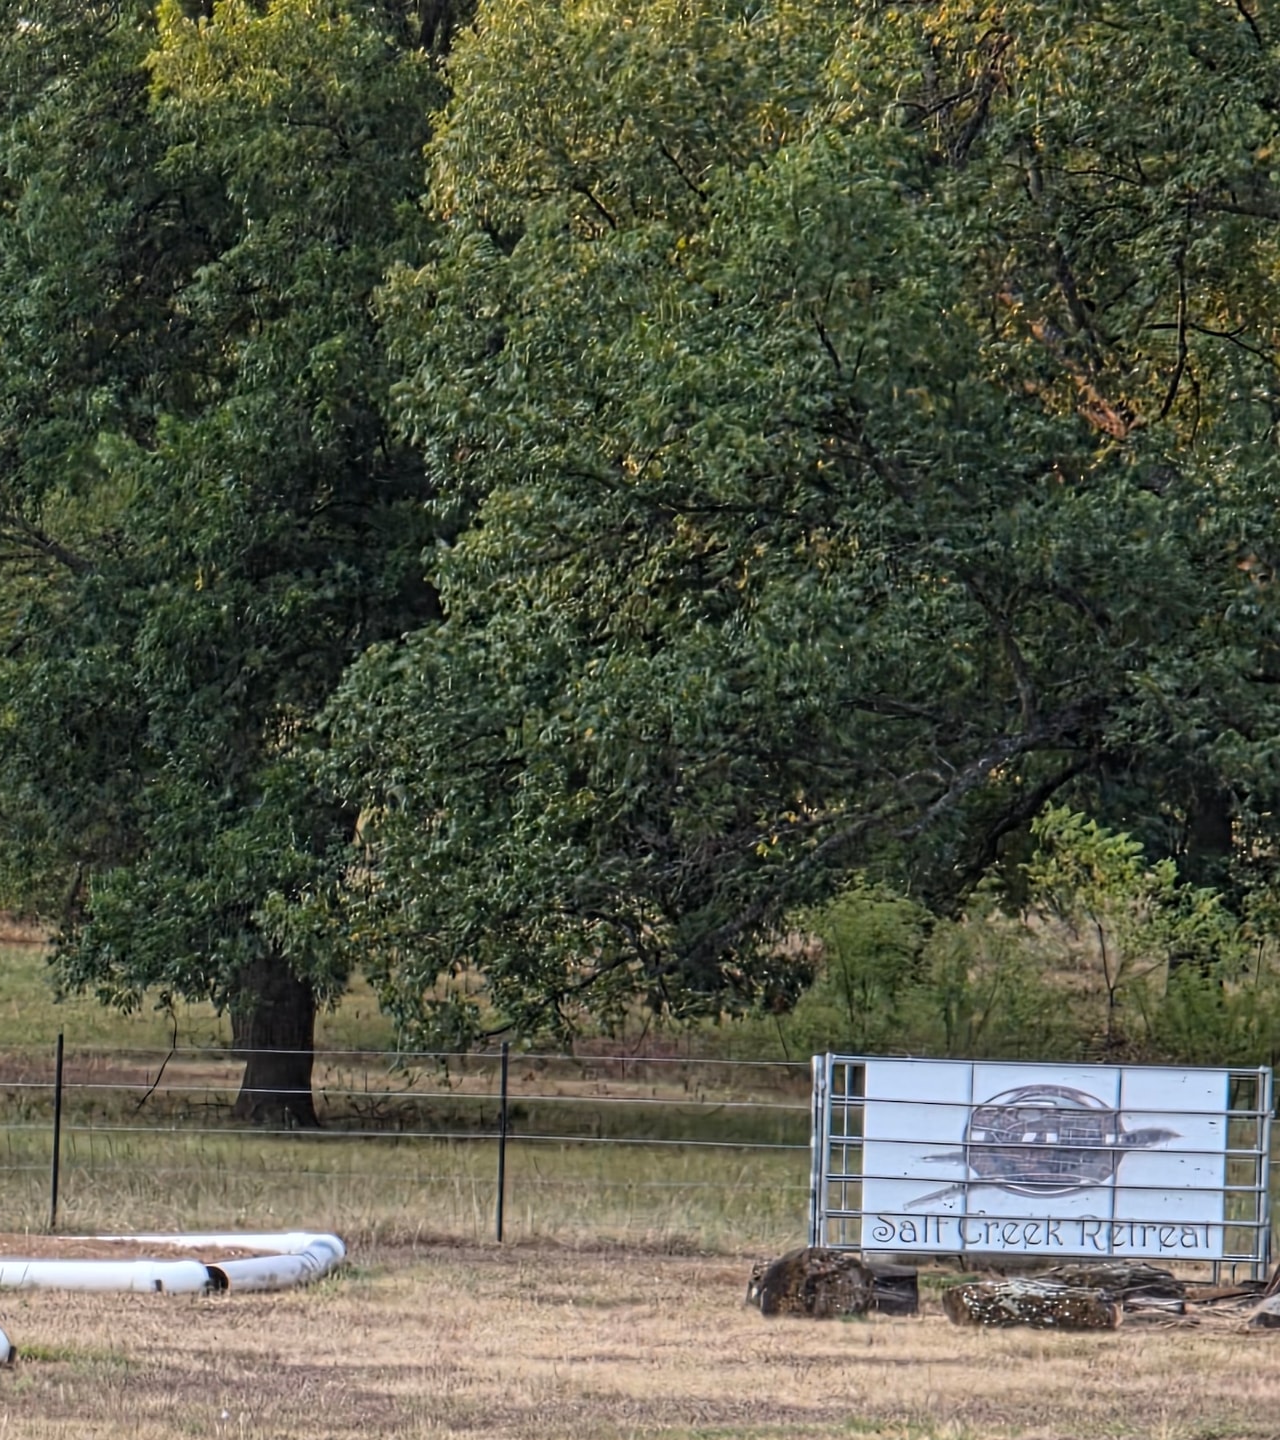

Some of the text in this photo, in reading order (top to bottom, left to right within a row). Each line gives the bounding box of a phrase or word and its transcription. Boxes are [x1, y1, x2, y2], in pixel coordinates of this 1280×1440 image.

[872, 1210, 1210, 1252] Salt Creek Retreat
